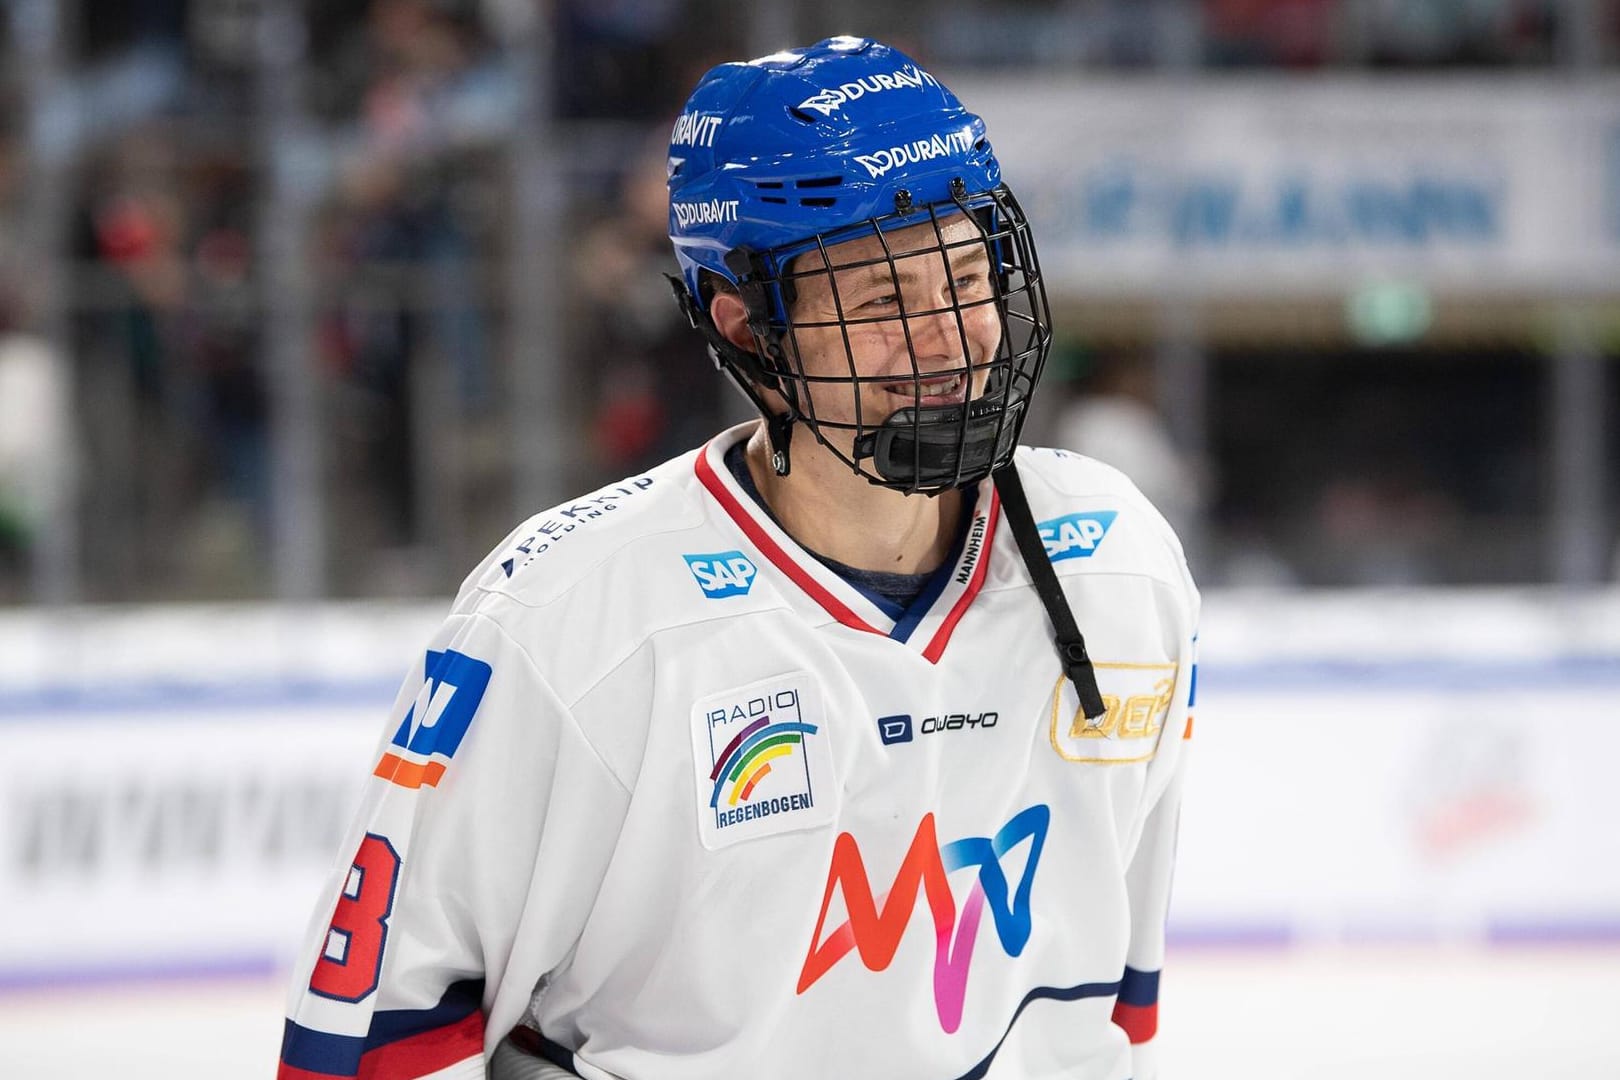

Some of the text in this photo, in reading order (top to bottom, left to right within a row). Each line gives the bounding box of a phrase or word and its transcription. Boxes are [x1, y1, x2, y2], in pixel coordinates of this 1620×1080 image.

[890, 131, 970, 168] DURAVIT
[687, 198, 739, 224] DURAVIT
[524, 503, 617, 566] OLDING
[956, 516, 986, 585] MANNHEIM
[1039, 519, 1104, 558] SAP
[690, 558, 755, 591] SAP
[711, 690, 796, 728] RADIO
[719, 793, 810, 829] REGENBOGEN
